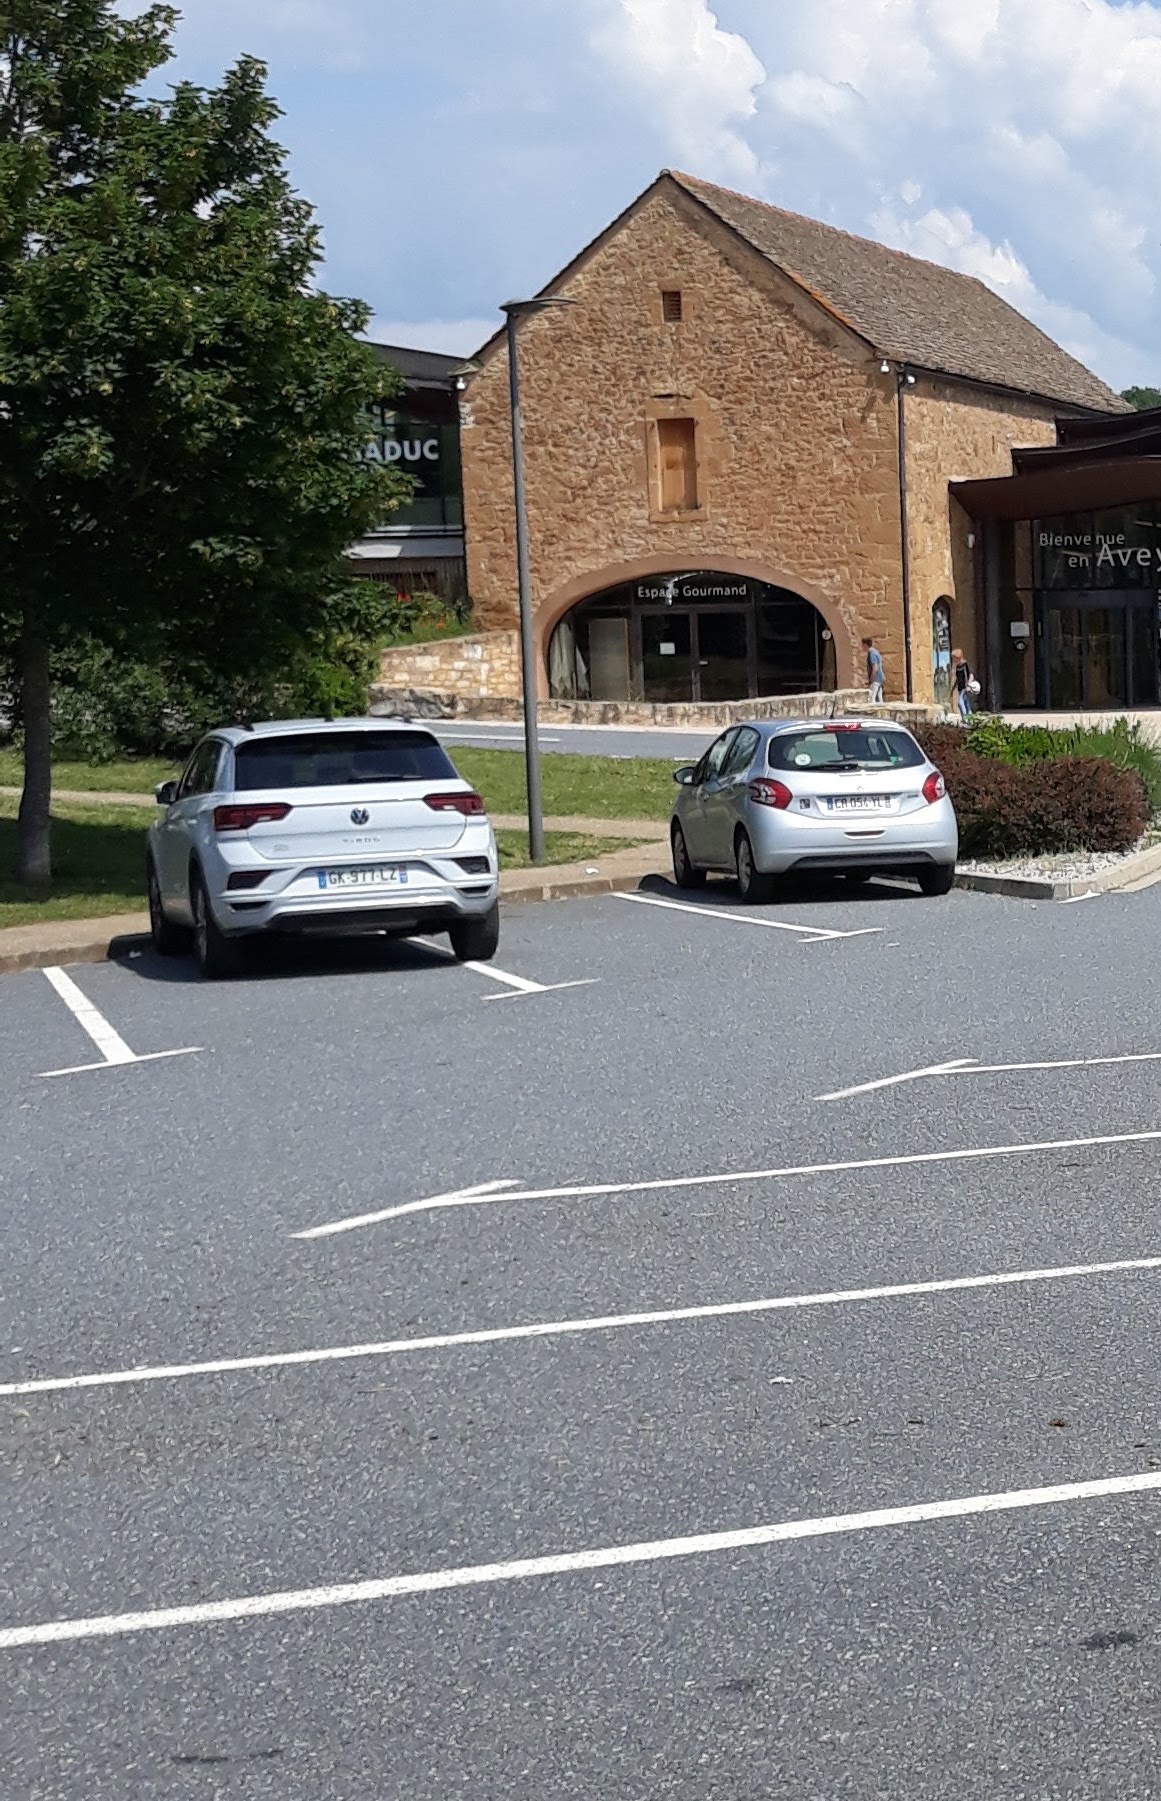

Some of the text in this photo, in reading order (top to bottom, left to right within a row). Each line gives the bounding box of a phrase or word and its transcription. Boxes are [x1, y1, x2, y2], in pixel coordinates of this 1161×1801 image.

[1039, 532, 1126, 547] Bienvenue
[1068, 556, 1090, 568] en
[682, 584, 748, 598] Gourmand
